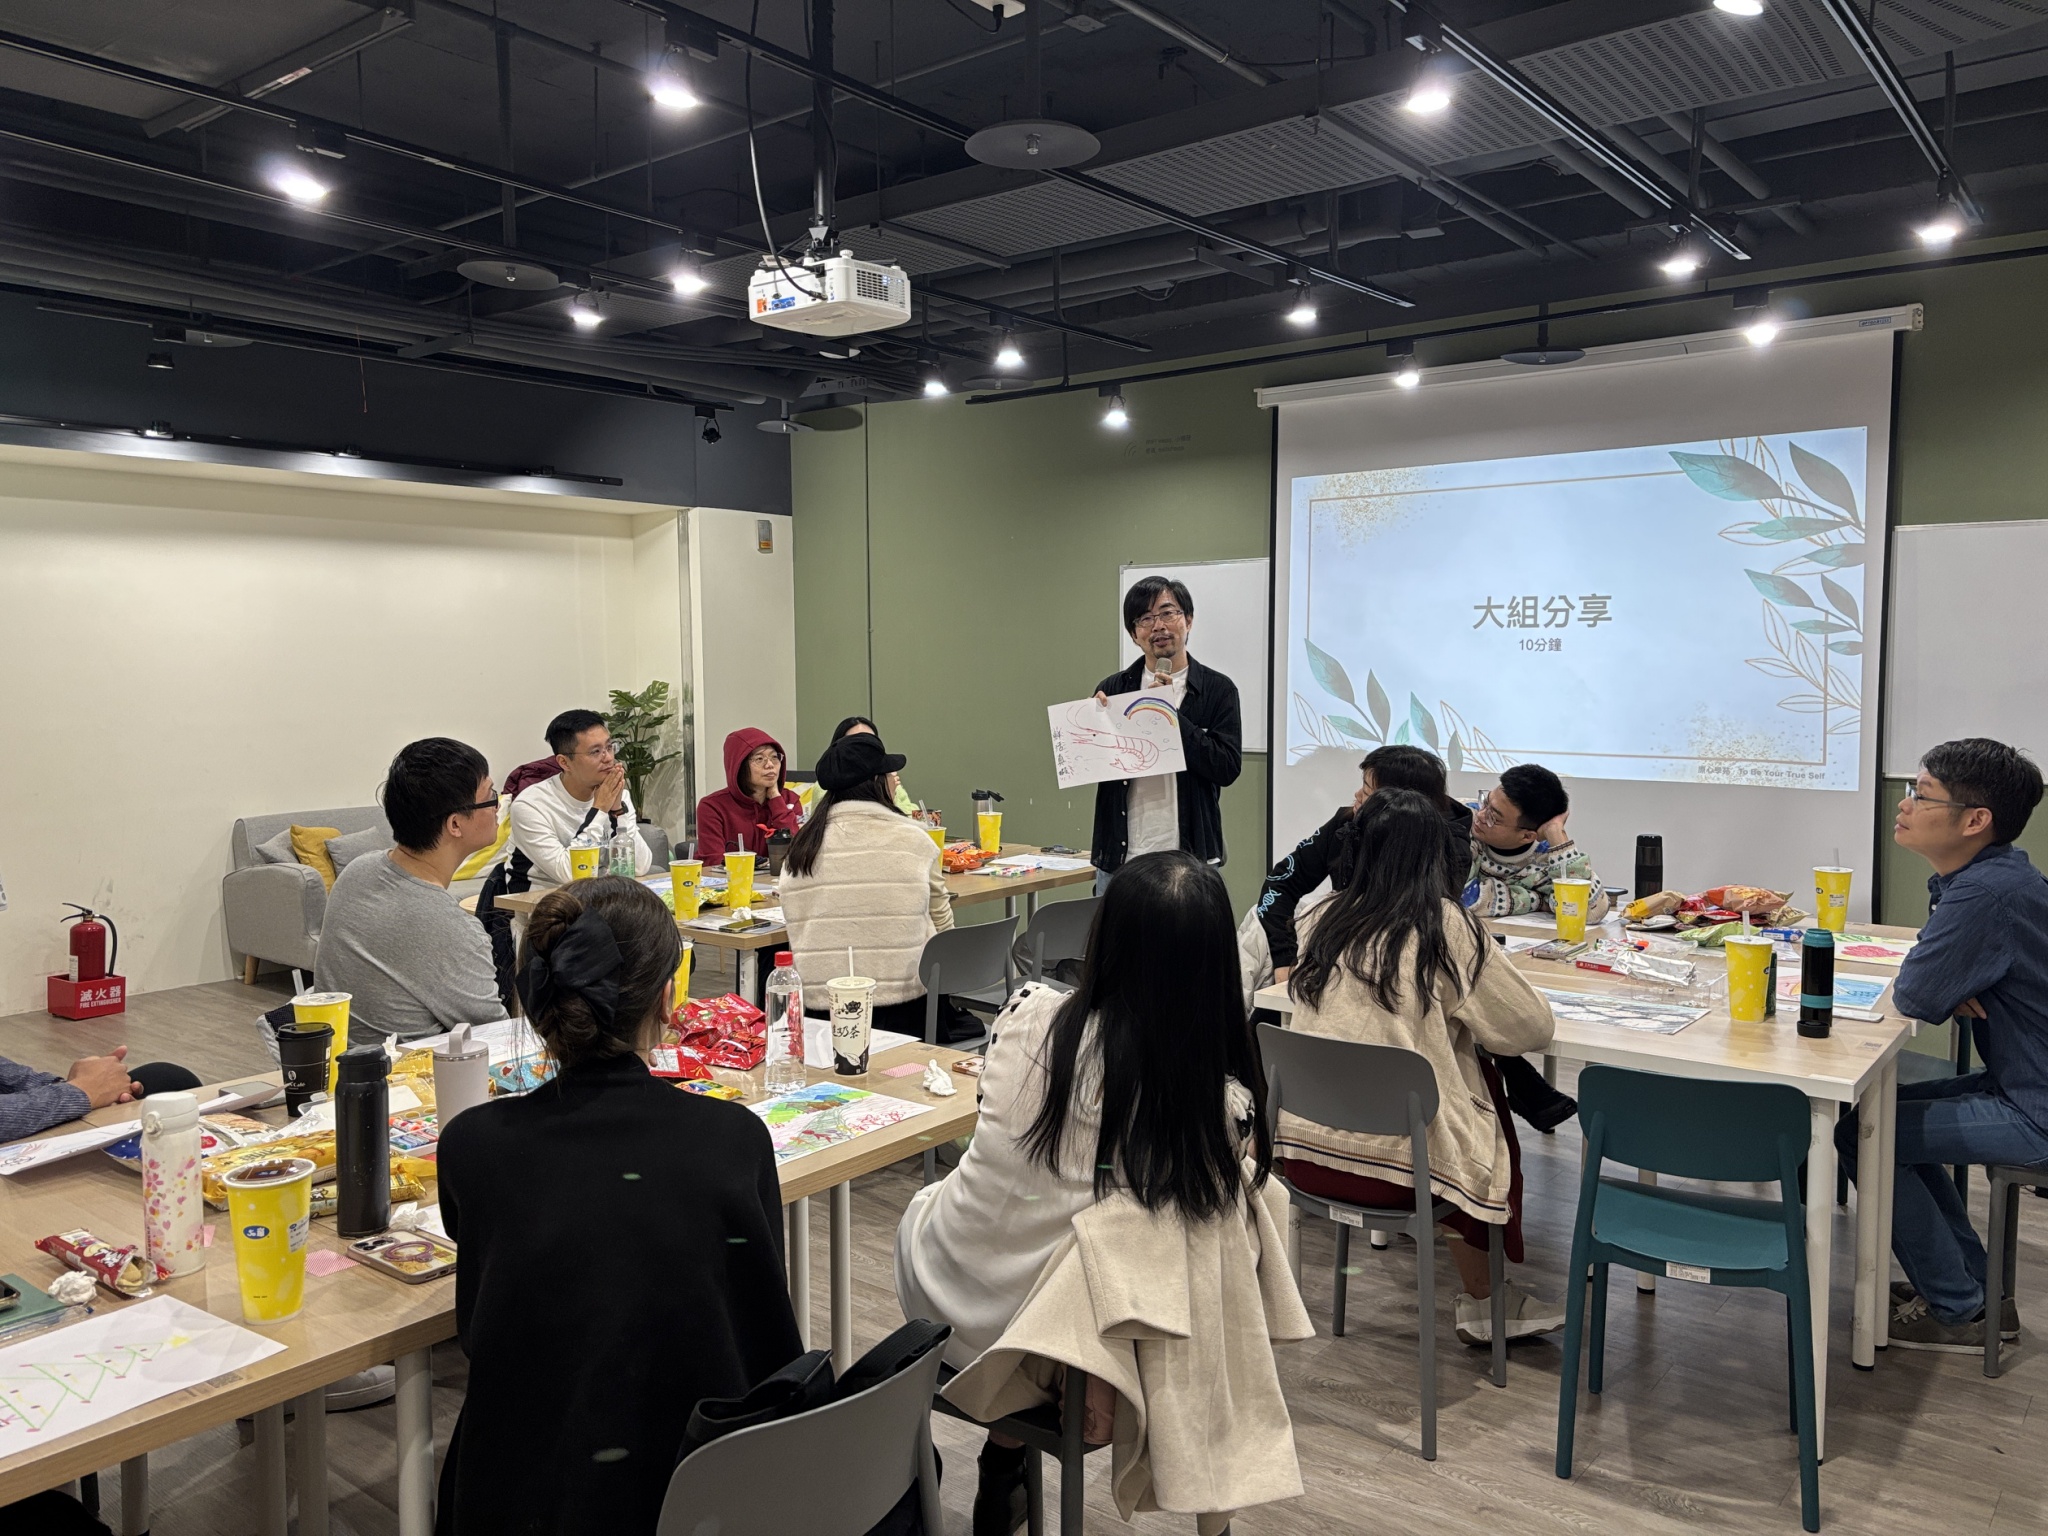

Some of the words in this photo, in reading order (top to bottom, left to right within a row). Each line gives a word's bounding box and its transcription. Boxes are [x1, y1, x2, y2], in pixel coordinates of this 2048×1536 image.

[1472, 593, 1613, 630] 大組分享
[1518, 637, 1563, 652] 10分鐘
[1739, 768, 1749, 776] To
[1764, 769, 1784, 778] Your
[1786, 771, 1806, 779] True
[1808, 772, 1826, 780] Self
[80, 985, 122, 1002] 滅火器
[80, 1001, 90, 1009] FIRE
